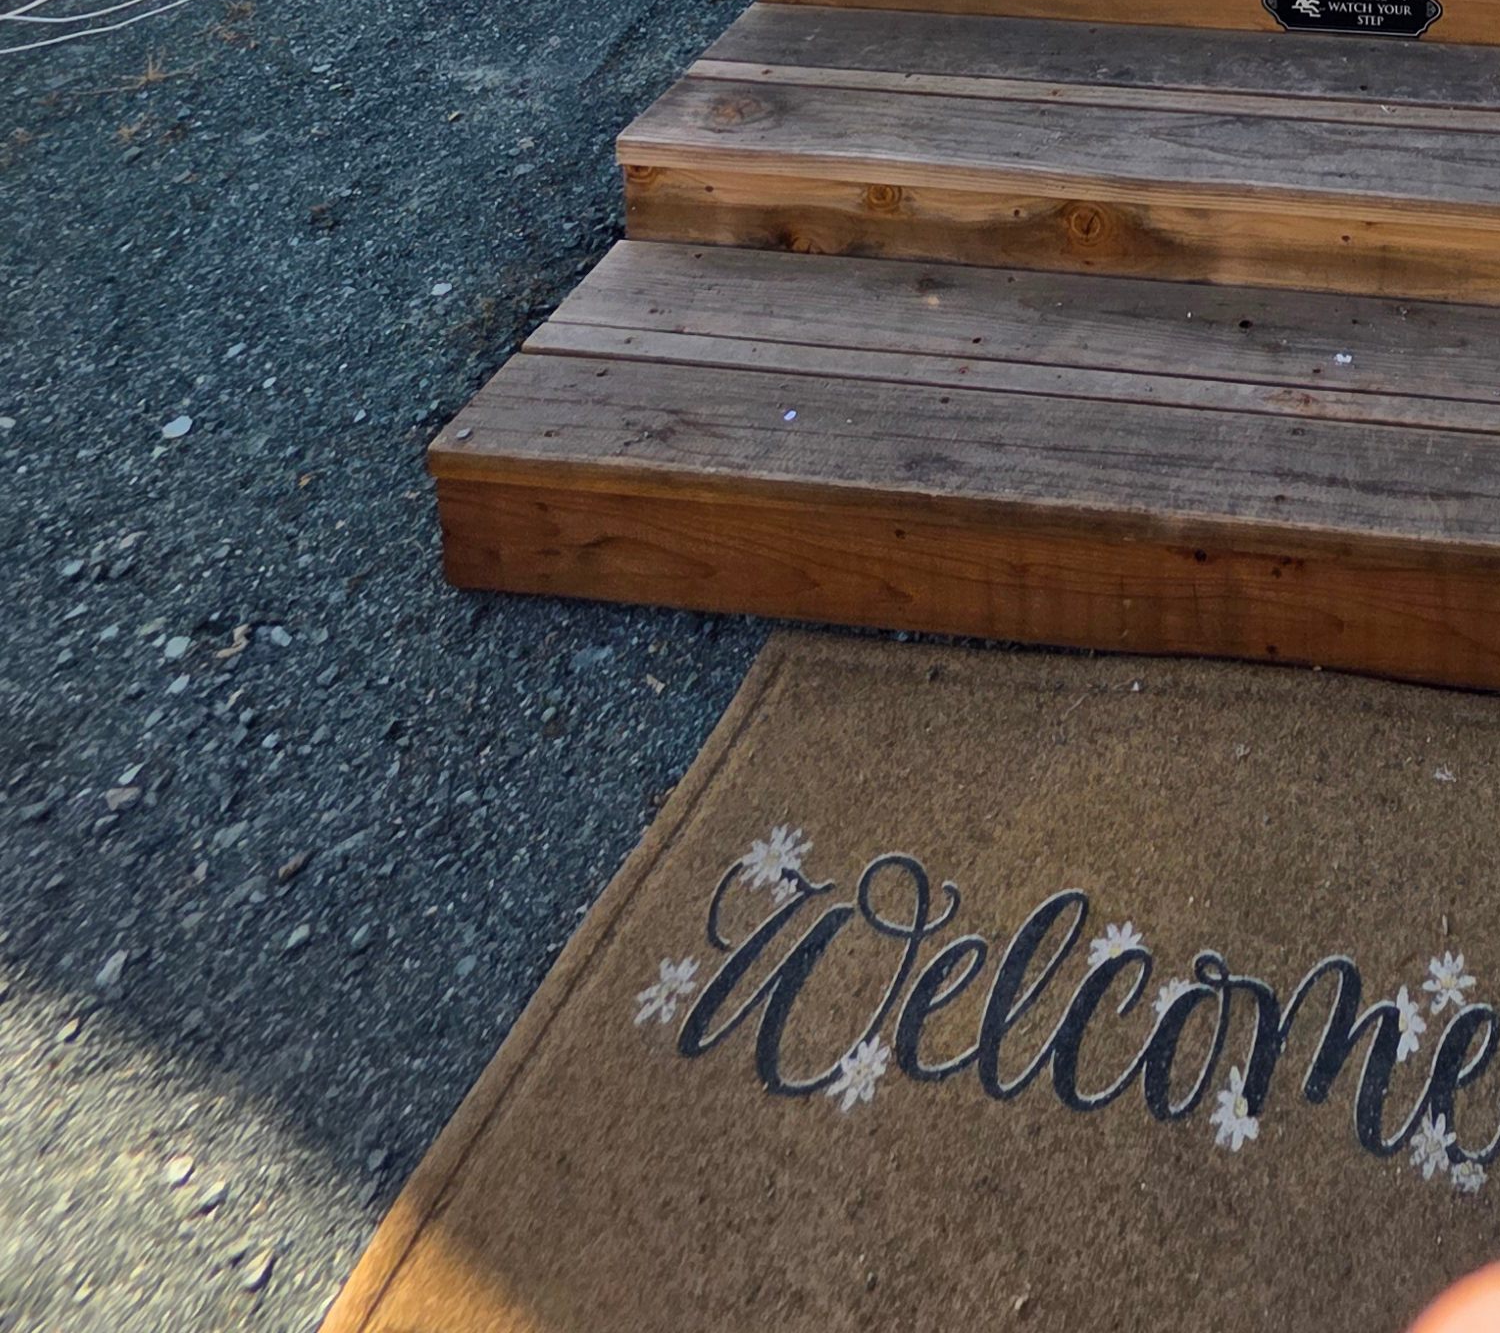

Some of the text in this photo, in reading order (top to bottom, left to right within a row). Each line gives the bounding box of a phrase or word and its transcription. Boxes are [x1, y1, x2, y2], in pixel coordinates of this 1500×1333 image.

[1328, 0, 1412, 16] WATCH YOUR
[1357, 14, 1384, 26] STEP
